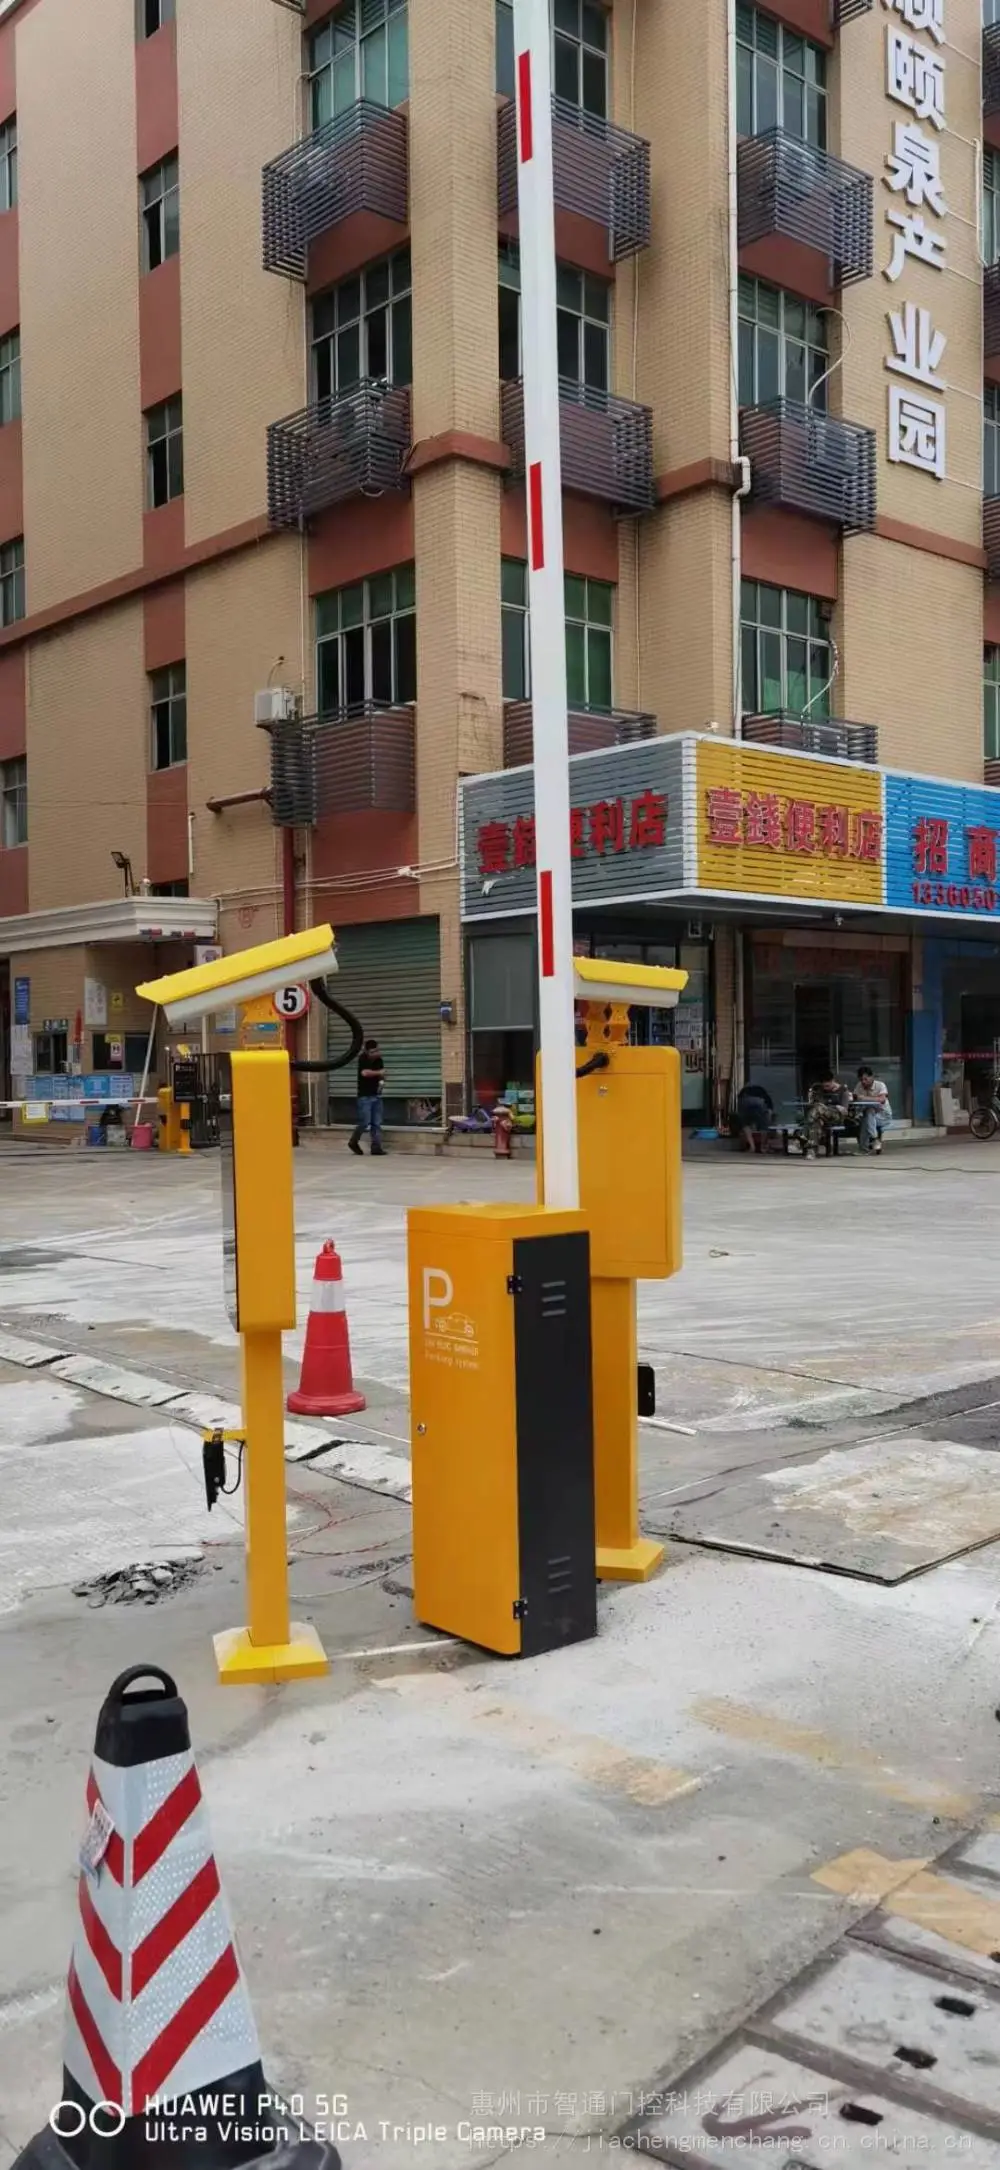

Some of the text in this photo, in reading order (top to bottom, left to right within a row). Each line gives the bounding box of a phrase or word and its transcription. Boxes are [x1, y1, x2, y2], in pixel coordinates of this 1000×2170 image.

[707, 785, 882, 860] 壹錢便利店
[912, 816, 998, 882] 招商
[282, 987, 297, 1012] 5
[423, 1267, 453, 1330] P
